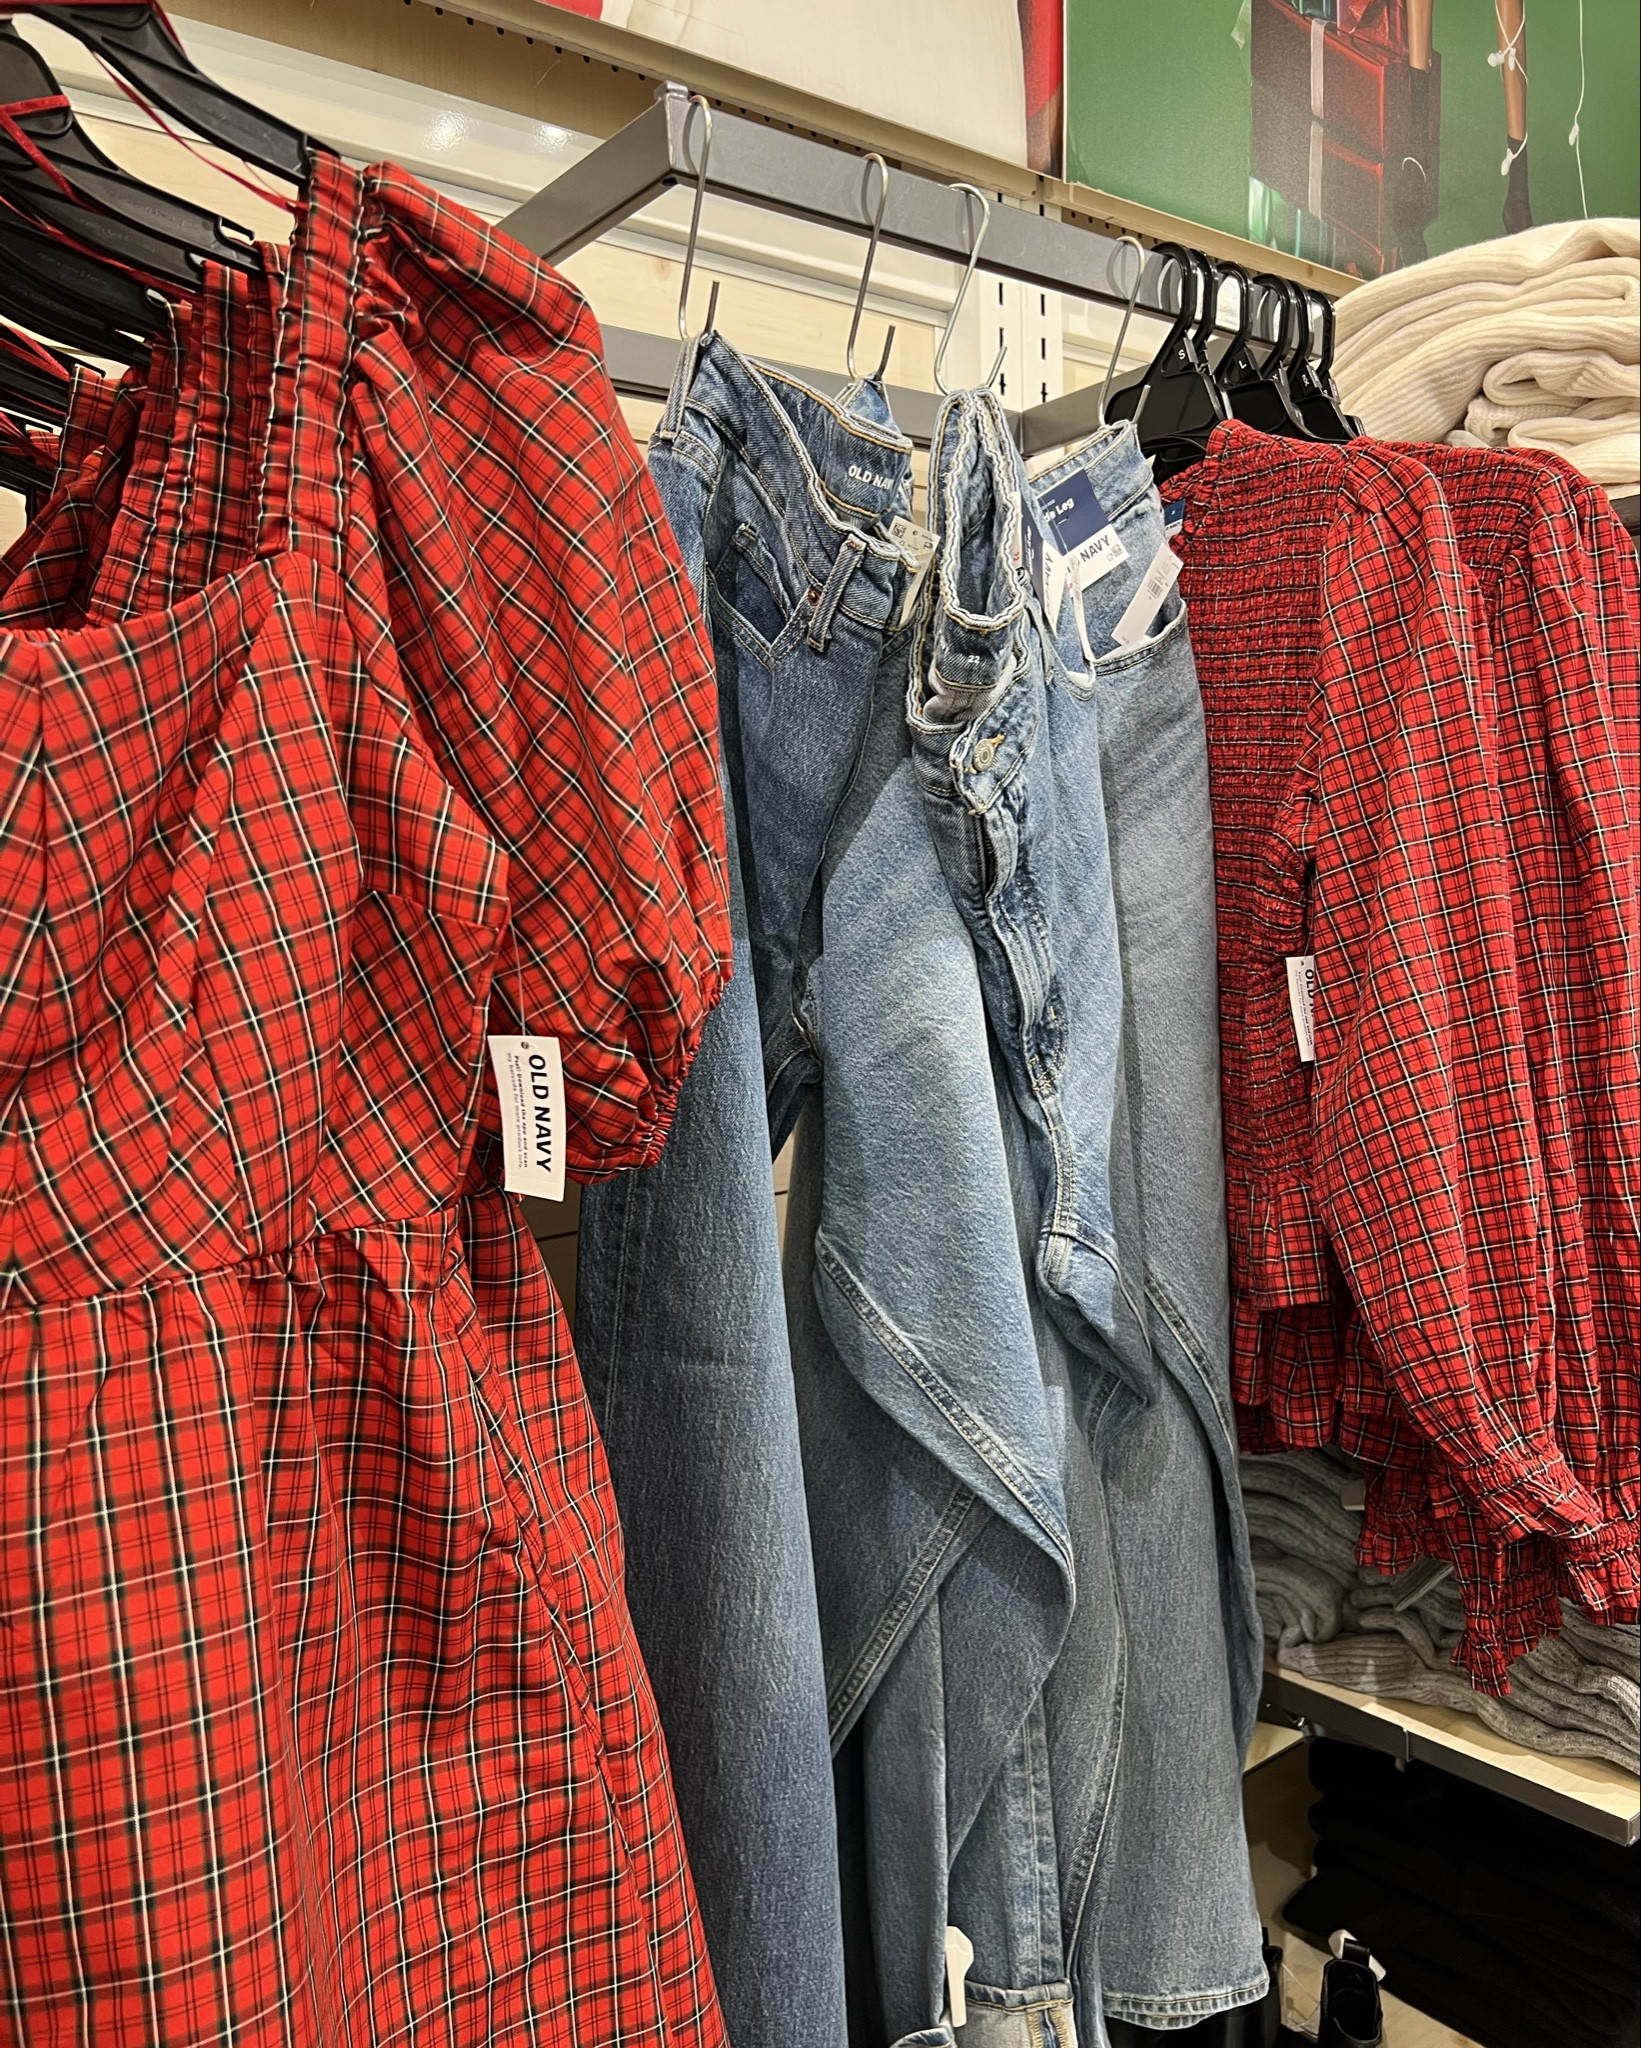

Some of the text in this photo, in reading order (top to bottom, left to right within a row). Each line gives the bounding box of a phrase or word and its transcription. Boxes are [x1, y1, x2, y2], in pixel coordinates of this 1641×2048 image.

[1178, 349, 1186, 360] S
[1238, 359, 1248, 371] L
[848, 464, 872, 483] OLD
[1055, 498, 1075, 515] Leg
[1079, 534, 1110, 562] NAVY
[967, 654, 981, 664] 22
[517, 1073, 526, 1108] Download
[508, 1064, 517, 1092] barcode
[515, 1124, 523, 1152] product
[529, 1054, 552, 1173] OLD NAVY
